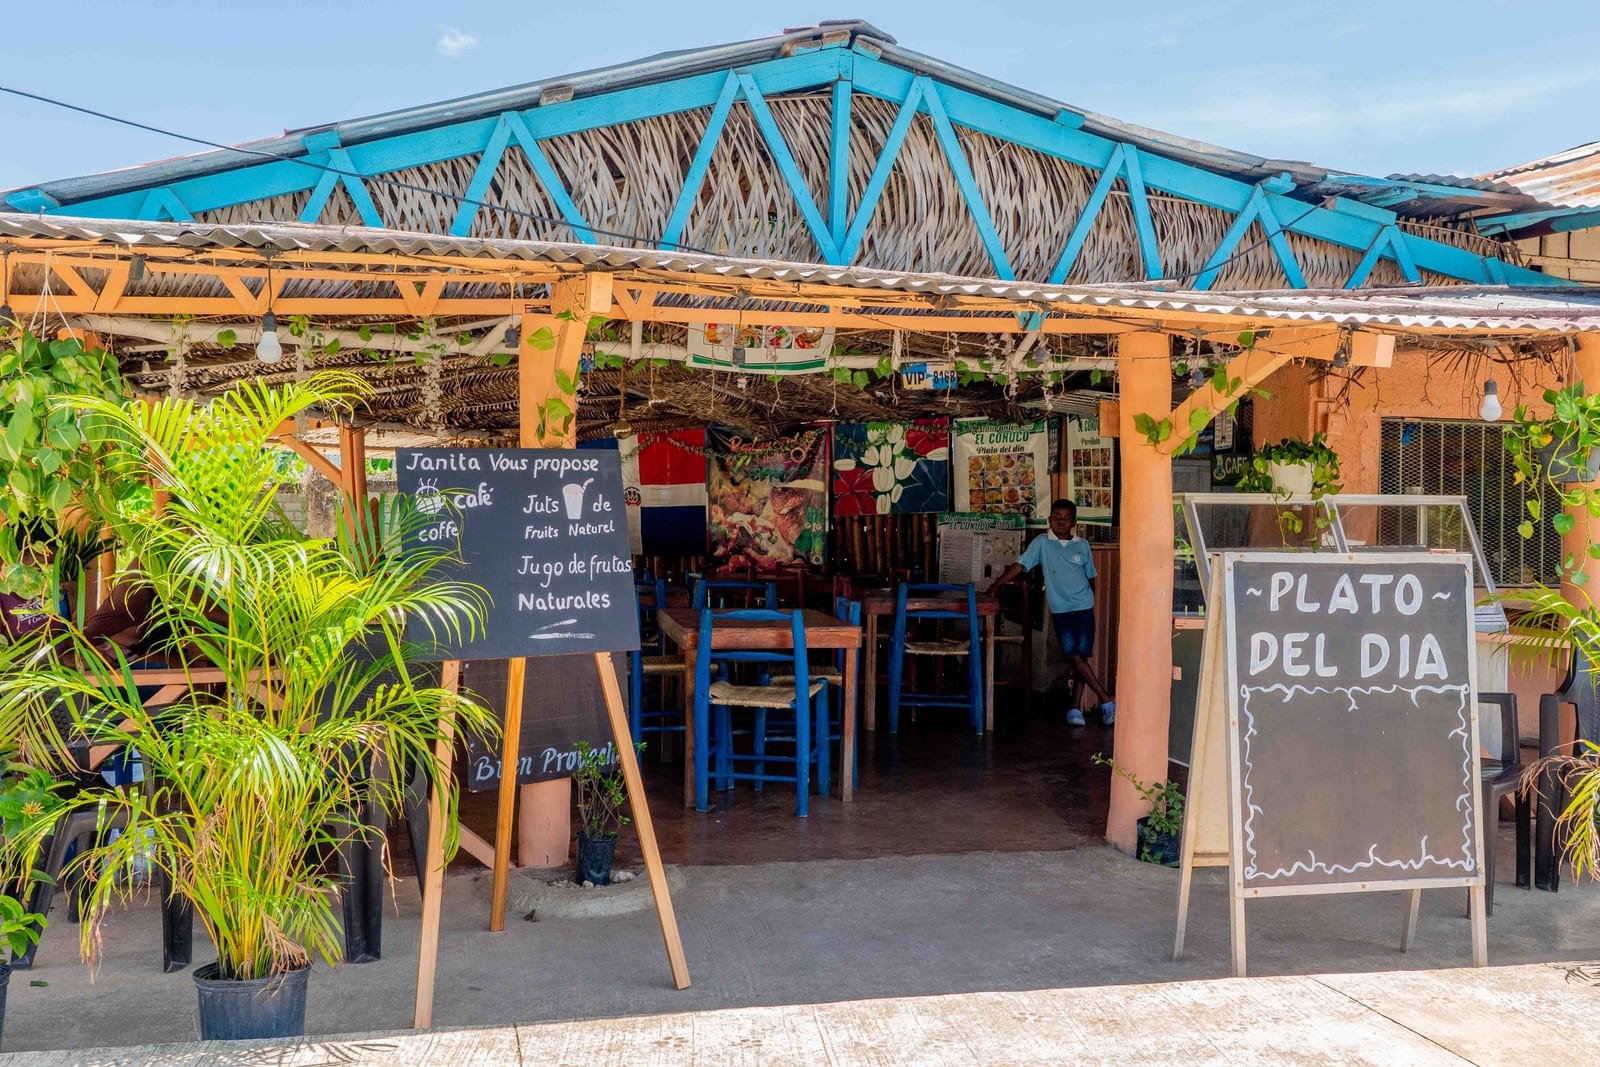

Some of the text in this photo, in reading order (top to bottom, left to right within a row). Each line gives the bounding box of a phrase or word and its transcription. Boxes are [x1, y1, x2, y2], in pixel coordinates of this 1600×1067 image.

[905, 371, 925, 385] VIP
[975, 431, 1031, 444] EL CONUCO
[406, 453, 599, 478] Janita Vous propose
[453, 482, 494, 510] café
[592, 494, 612, 513] de
[418, 521, 459, 542] coffe
[524, 525, 559, 540] Fruits
[517, 553, 632, 588] Jugo de frutas
[518, 591, 611, 612] Naturales
[1269, 571, 1424, 616] PLATO
[1249, 631, 1449, 680] DEL DIA
[474, 756, 532, 782] Bn
